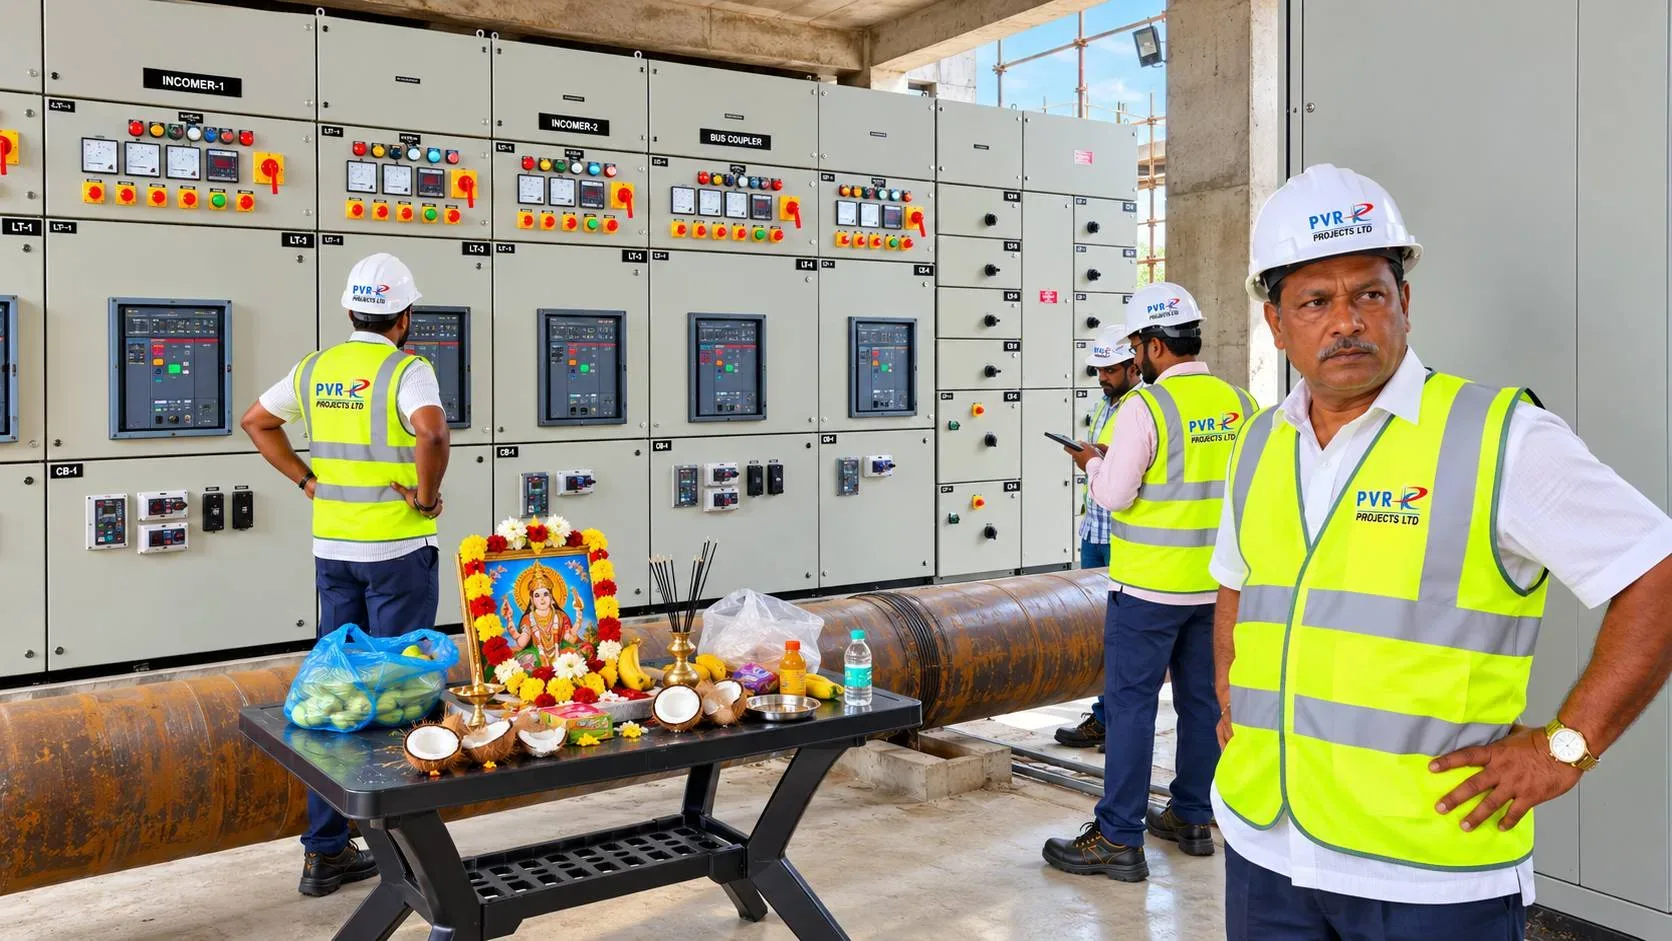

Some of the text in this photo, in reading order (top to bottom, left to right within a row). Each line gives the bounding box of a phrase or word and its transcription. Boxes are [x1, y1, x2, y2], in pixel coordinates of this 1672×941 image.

[162, 75, 224, 91] INCOMER-1
[551, 118, 598, 132] INCOMER-2
[710, 133, 762, 146] BUS COUPLER
[1308, 210, 1344, 230] PVR
[12, 222, 32, 232] LT-1
[1313, 225, 1373, 242] PROJECTS LTD
[352, 285, 372, 295] PVR
[1147, 302, 1165, 313] PVR
[316, 382, 344, 396] PVR
[316, 400, 364, 410] PROJECTS LTD
[1189, 417, 1215, 433] PVR
[1191, 433, 1236, 444] PROJECTS LTD
[56, 466, 77, 476] CB-1
[1356, 490, 1393, 507] PVR
[1356, 512, 1419, 525] PROJECTS LTD
